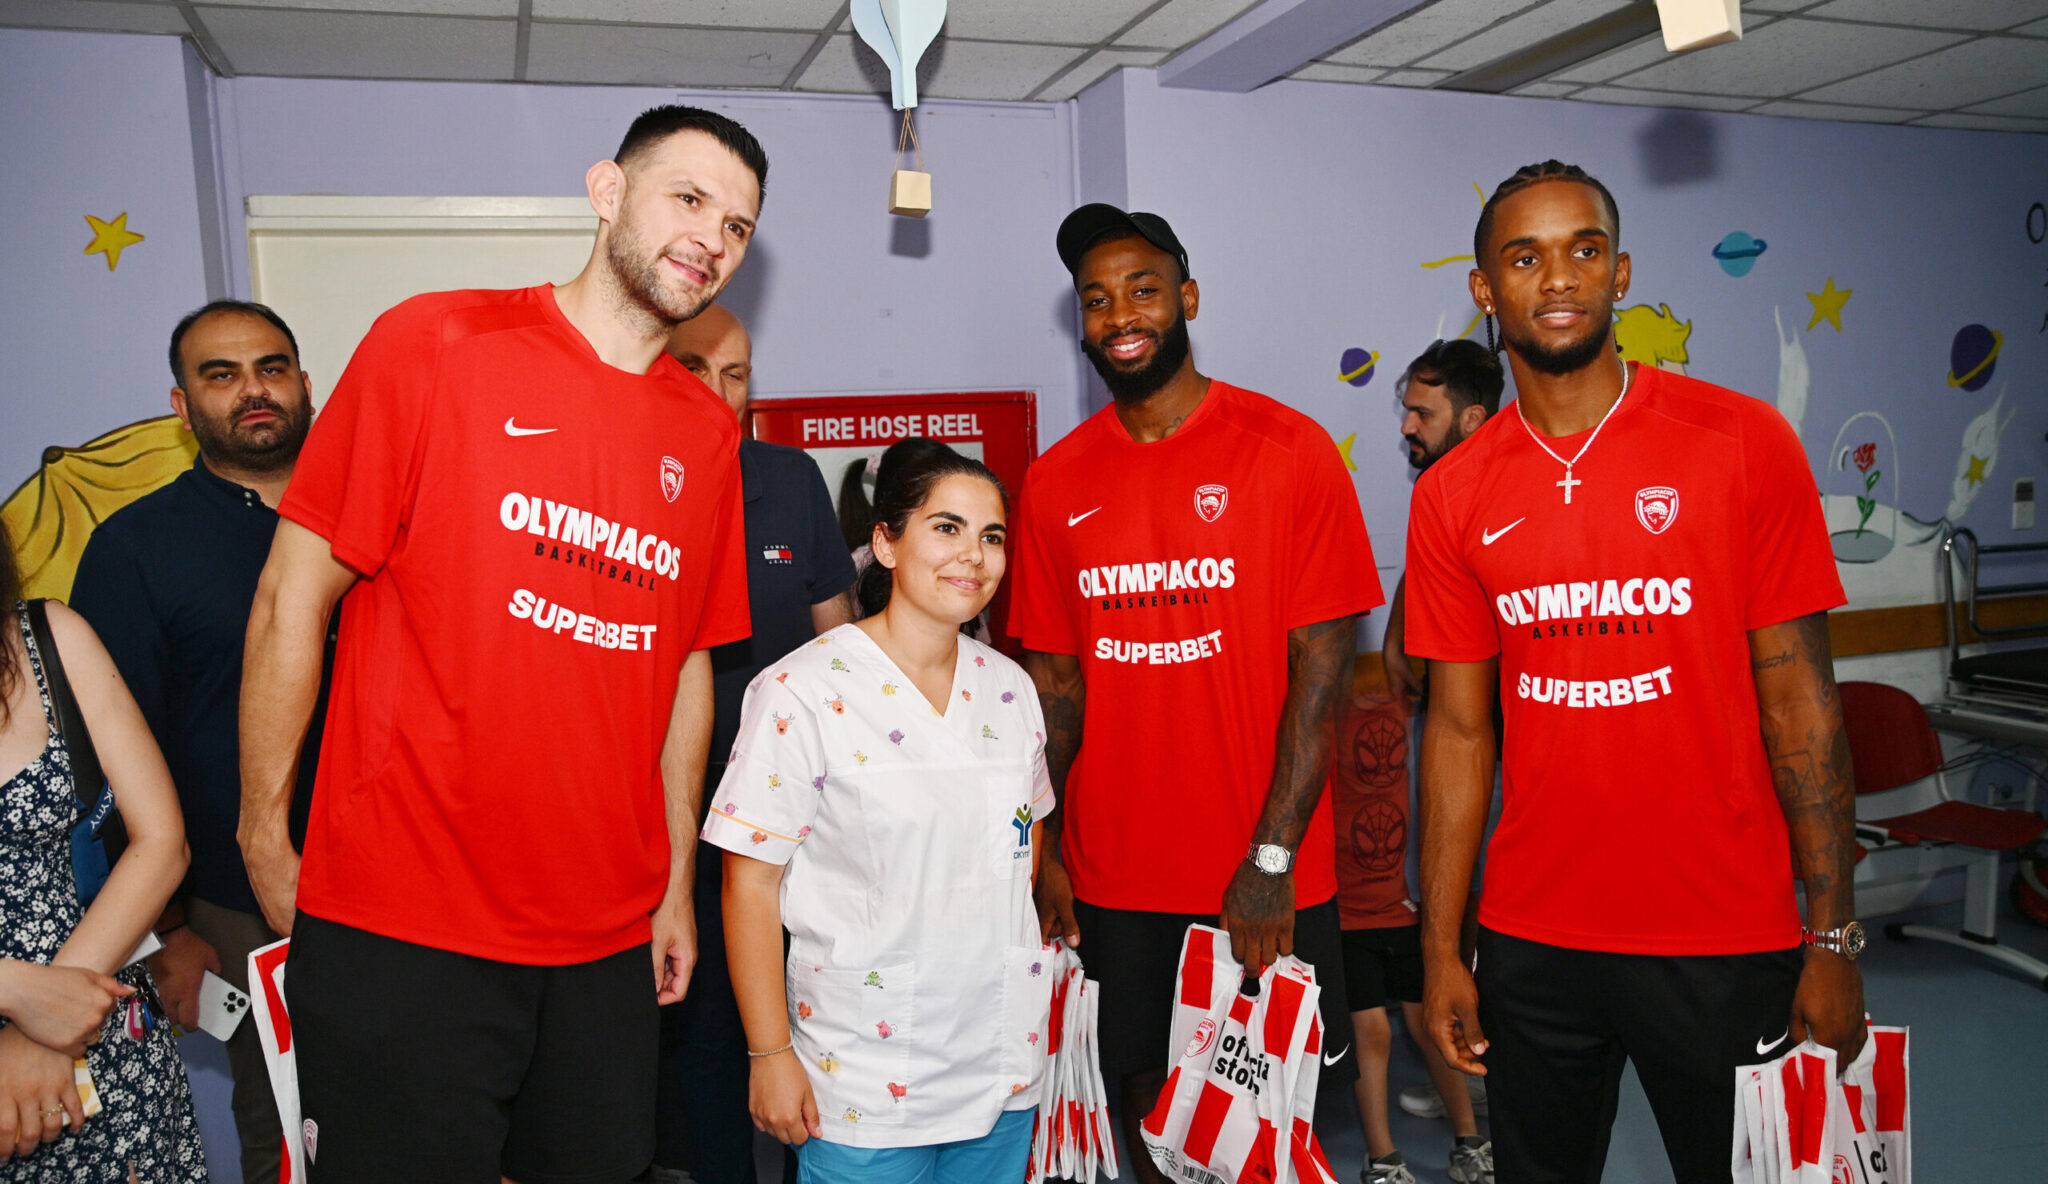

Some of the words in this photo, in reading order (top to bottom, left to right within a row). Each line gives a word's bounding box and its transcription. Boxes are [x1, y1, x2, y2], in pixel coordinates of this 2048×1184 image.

[803, 417, 855, 441] FIRE
[860, 415, 923, 439] HOSE
[927, 413, 984, 436] REEL
[500, 492, 682, 581] OLYMPIACOS
[535, 542, 656, 592] BASKETBALL
[1078, 557, 1236, 599] OLYMPIACOS
[508, 588, 657, 651] SUPERBET
[1102, 592, 1210, 611] BASKETBALL
[1496, 577, 1692, 626] OLYMPIACOS
[1095, 629, 1222, 665] SUPERBET
[1531, 620, 1655, 640] ASKETBALL
[1517, 665, 1673, 708] SUPERBET
